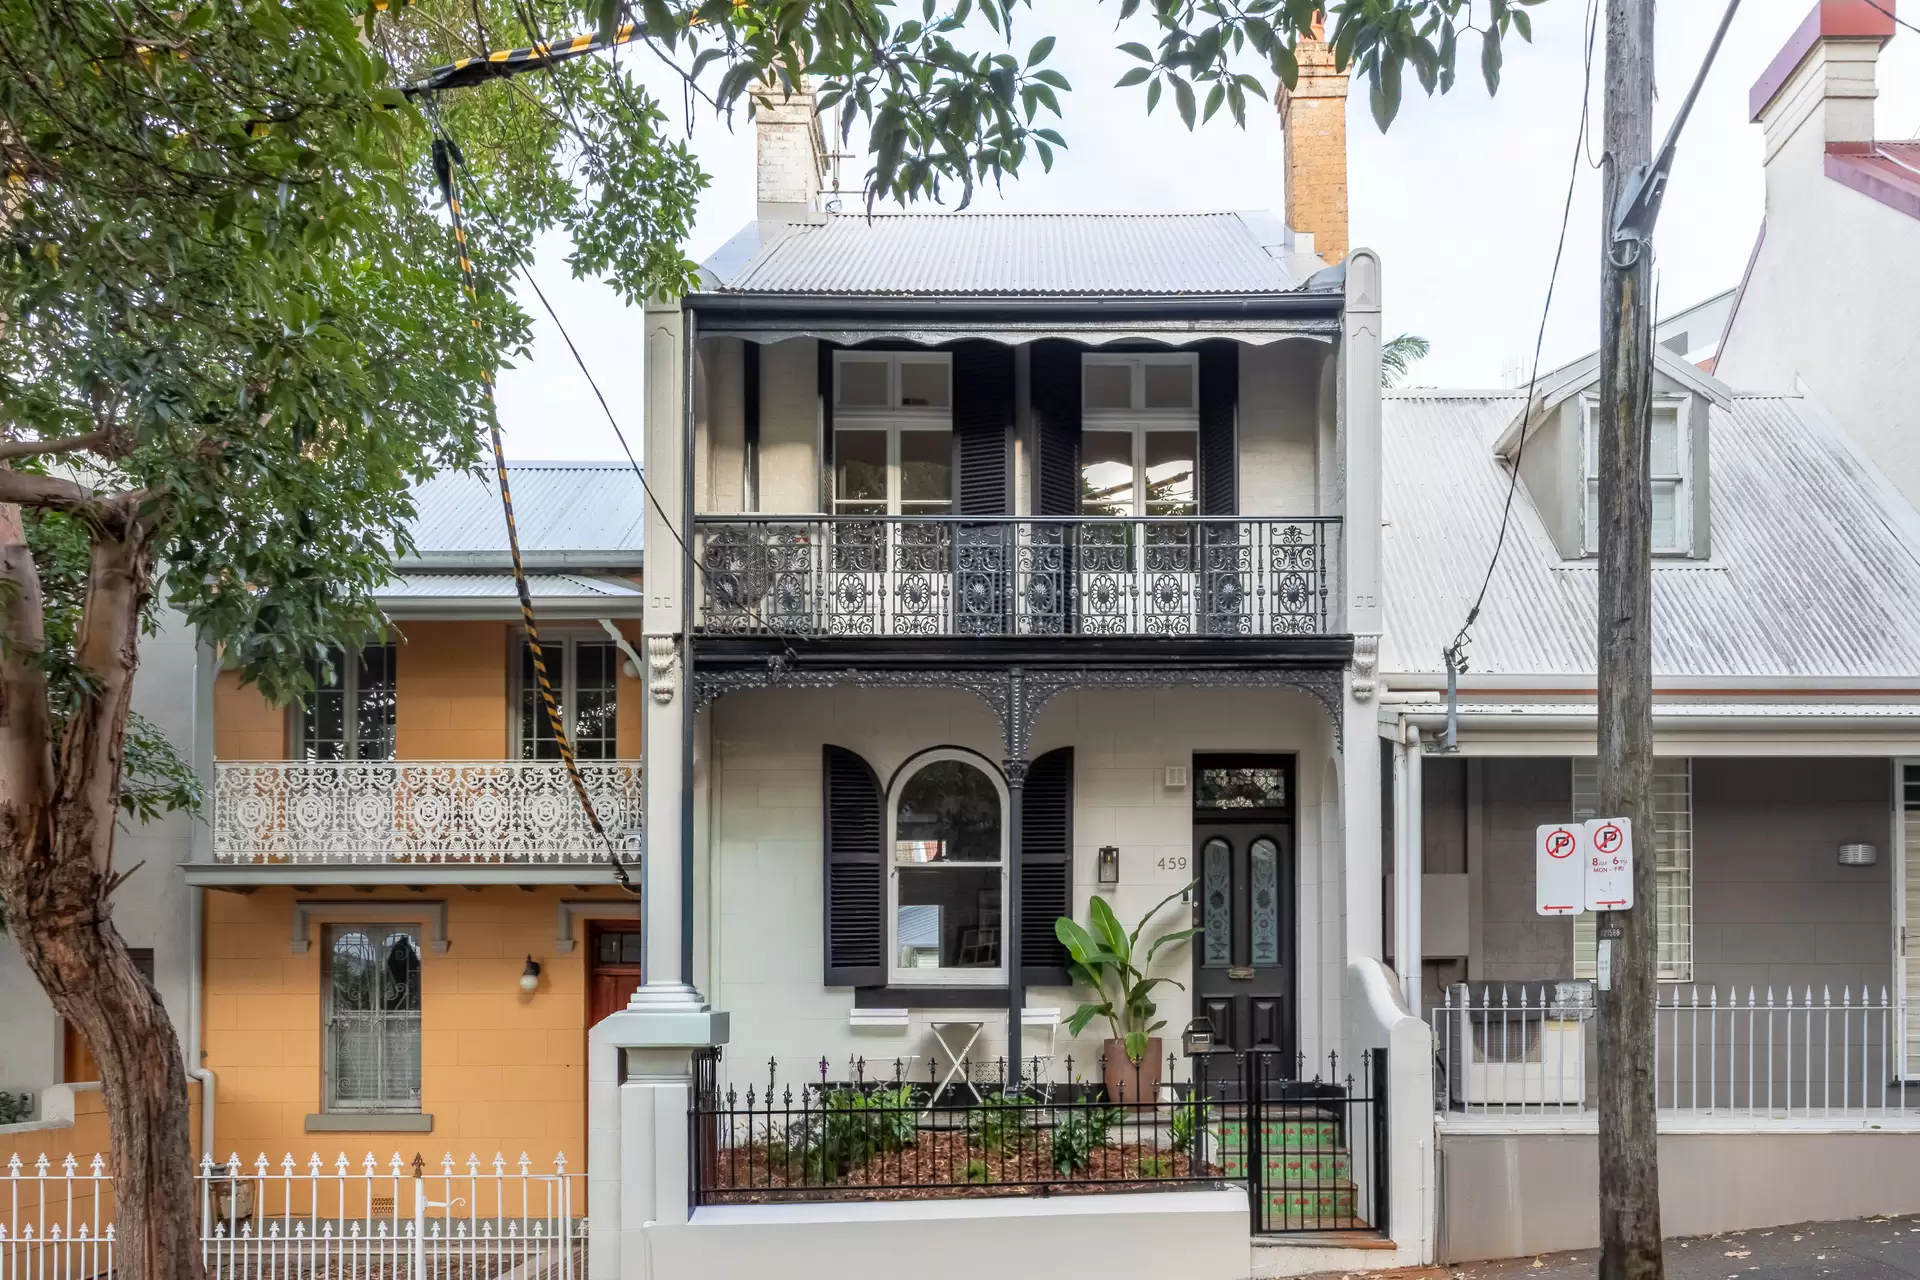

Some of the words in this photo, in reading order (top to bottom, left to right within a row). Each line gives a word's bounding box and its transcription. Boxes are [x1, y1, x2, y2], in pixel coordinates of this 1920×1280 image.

[1555, 837, 1569, 853] P
[1603, 831, 1617, 848] P
[1157, 856, 1187, 870] 459
